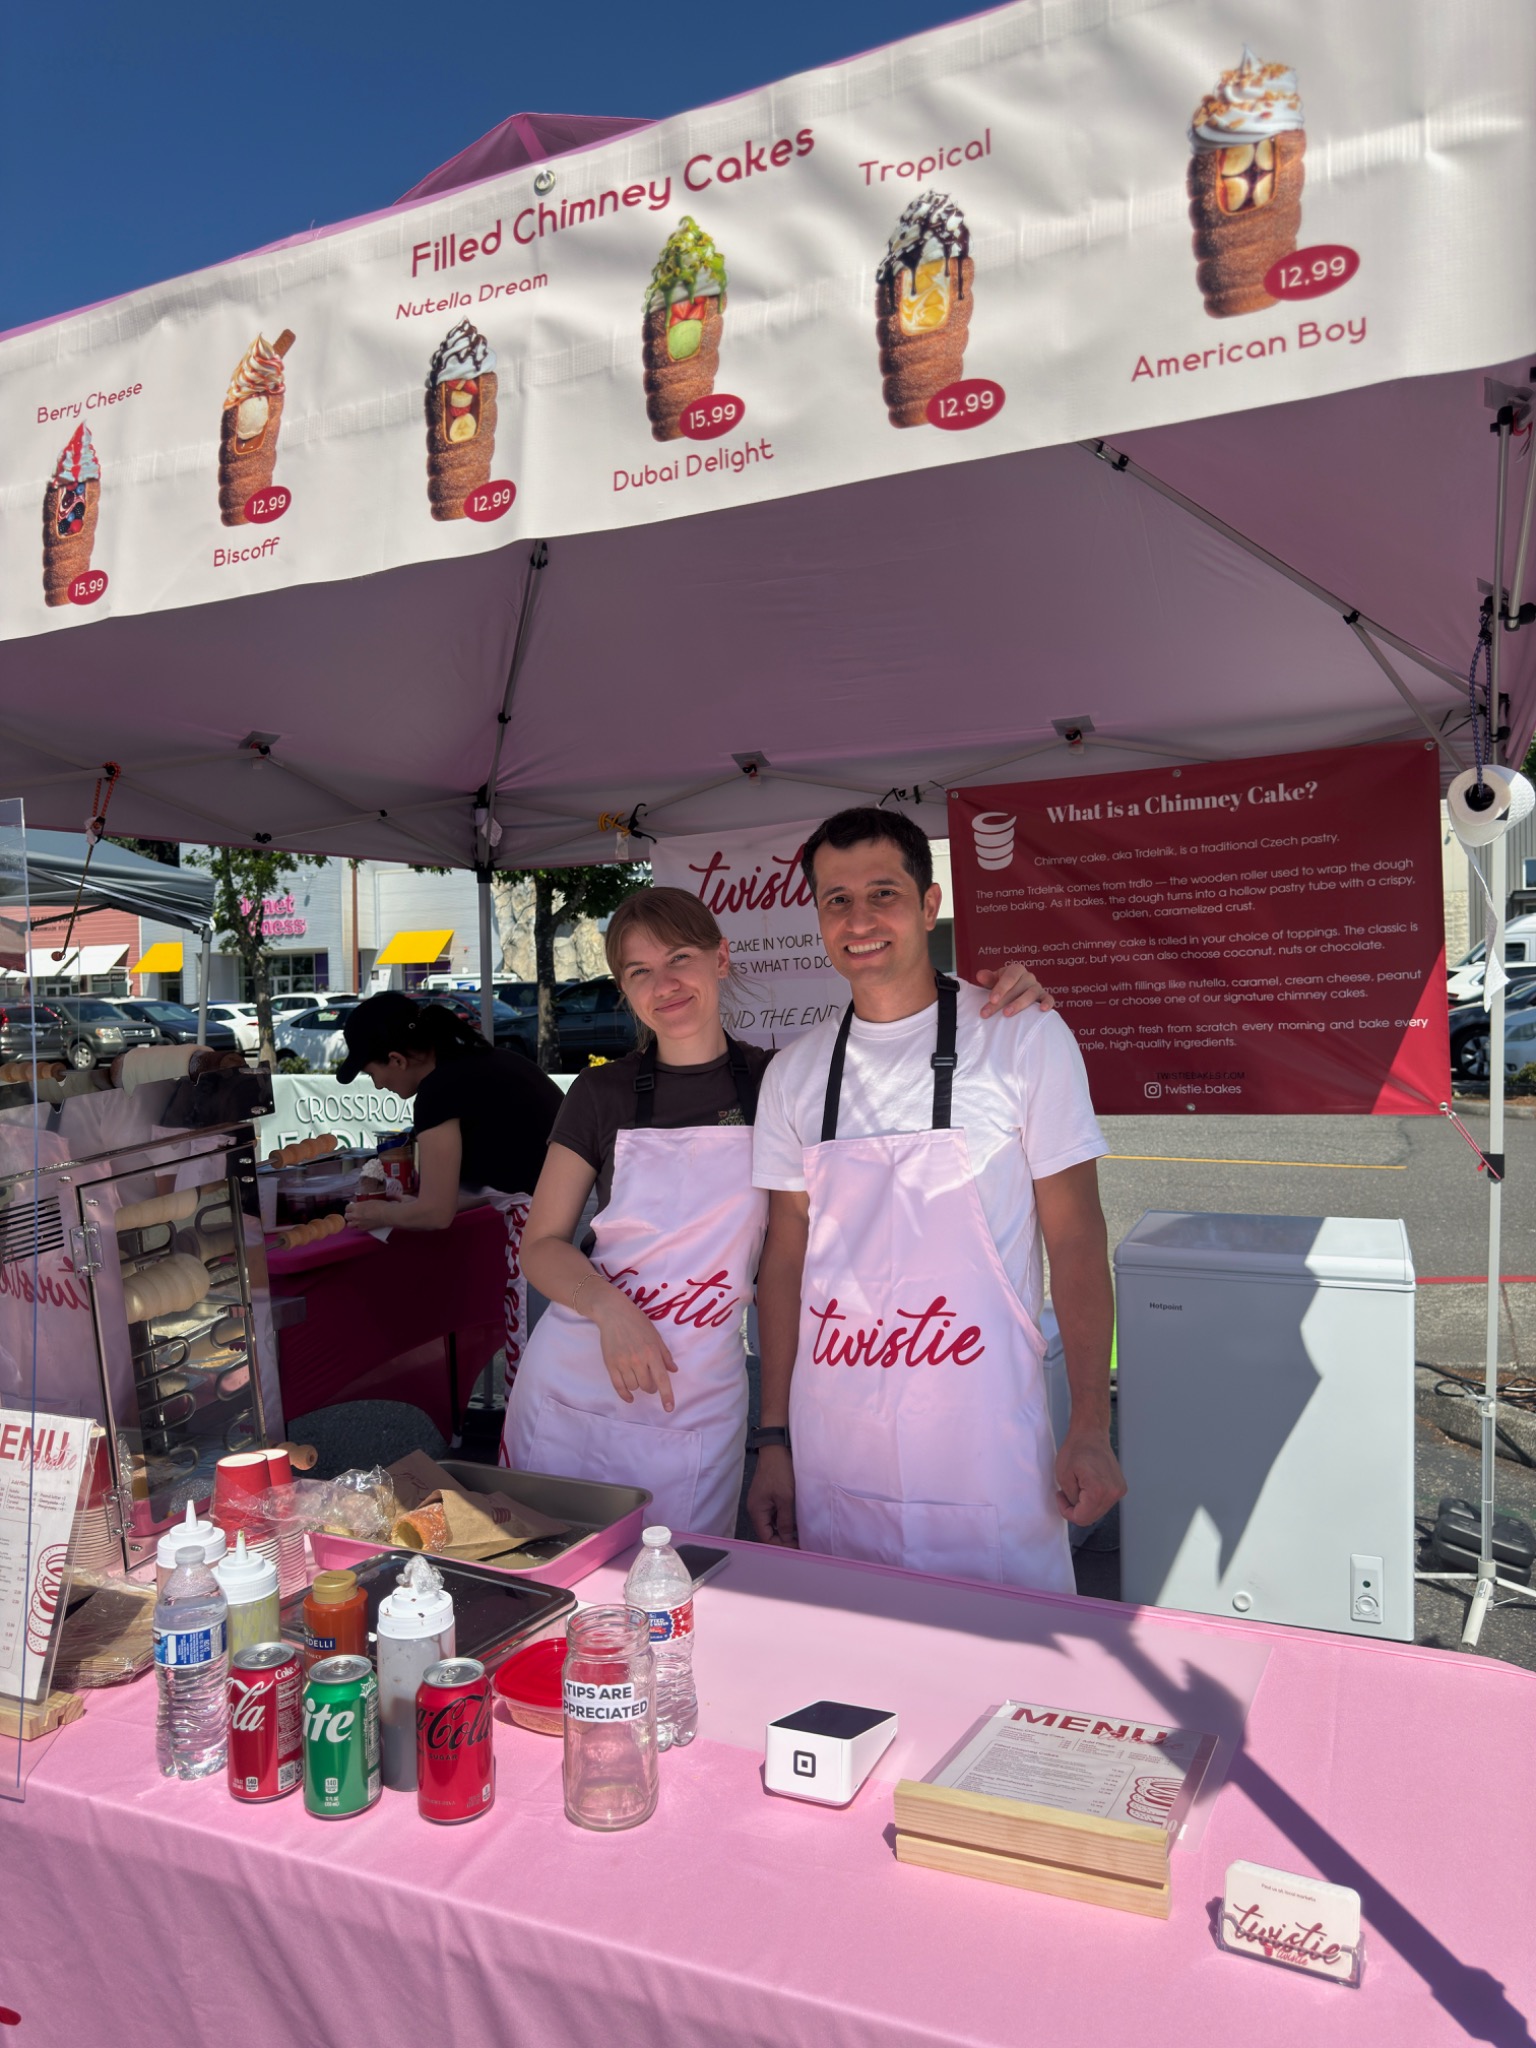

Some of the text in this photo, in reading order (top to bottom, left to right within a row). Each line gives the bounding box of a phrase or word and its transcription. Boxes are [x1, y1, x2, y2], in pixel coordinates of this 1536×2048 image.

[859, 128, 991, 185] Tropical
[412, 128, 814, 278] Filled Chimney Cakes
[396, 273, 549, 320] Nutella Dream
[1131, 317, 1367, 382] American Boy
[37, 383, 142, 424] Berry Cheese
[613, 436, 774, 492] Dubai Delight
[213, 536, 280, 567] Biscoff
[1046, 781, 1317, 822] What is a Chimney Cake?
[1034, 856, 1078, 866] Chimney
[1112, 851, 1132, 860] aka
[1180, 846, 1187, 854] is
[1200, 839, 1257, 852] traditional
[1260, 836, 1298, 847] Czech
[689, 844, 818, 915] twisti
[995, 889, 1024, 897] name
[1066, 884, 1100, 892] comes
[1102, 882, 1126, 890] from
[1128, 878, 1152, 888] trdlo
[1169, 876, 1187, 885] the
[1190, 873, 1237, 883] wooden
[1240, 870, 1268, 880] roller
[1270, 867, 1298, 878] used
[1302, 867, 1313, 875] to
[1316, 865, 1346, 874] wrap
[1350, 862, 1370, 871] the
[1373, 858, 1413, 870] dough
[976, 904, 1007, 913] before
[1050, 899, 1062, 907] As
[1065, 898, 1071, 906] it
[1128, 893, 1163, 904] dough
[1167, 892, 1192, 900] turns
[1195, 889, 1215, 898] into
[1230, 886, 1266, 896] hollow
[1270, 883, 1306, 895] pastry
[1308, 881, 1336, 890] tube
[1339, 878, 1363, 888] with
[1154, 904, 1222, 916] caramelized
[729, 938, 760, 953] CAKE
[763, 938, 774, 950] IN
[777, 934, 814, 949] YOUR
[978, 946, 1001, 954] After
[1042, 942, 1069, 951] each
[1072, 940, 1117, 949] chimney
[1119, 938, 1146, 947] cake
[1149, 937, 1155, 945] is
[1158, 936, 1186, 945] rolled
[1189, 935, 1198, 944] in
[1202, 935, 1226, 945] your
[1228, 932, 1268, 942] choice
[1272, 930, 1284, 939] of
[1344, 925, 1364, 934] The
[1368, 923, 1406, 934] classic
[1410, 922, 1418, 931] is
[751, 959, 789, 974] WHAT
[793, 958, 812, 970] TO
[1090, 954, 1108, 963] but
[1110, 954, 1129, 963] you
[1156, 951, 1178, 960] also
[1180, 950, 1220, 958] choose
[1278, 945, 1302, 954] nuts
[1071, 983, 1107, 994] special
[1110, 982, 1132, 991] with
[1134, 981, 1166, 991] fillings
[1168, 980, 1186, 988] like
[1284, 976, 1323, 985] cream
[1377, 970, 1422, 982] peanut
[1122, 996, 1161, 1005] choose
[1188, 993, 1200, 1003] of
[1224, 992, 1274, 1003] signature
[1277, 991, 1328, 1000] chimney
[760, 1007, 795, 1028] THE
[1100, 1026, 1134, 1036] dough
[1138, 1025, 1162, 1033] fresh
[1167, 1024, 1192, 1032] from
[1196, 1022, 1237, 1032] scratch
[1242, 1023, 1274, 1031] every
[1278, 1021, 1324, 1031] morning
[1330, 1020, 1354, 1029] and
[1358, 1019, 1389, 1028] bake
[1394, 1018, 1428, 1028] every
[1079, 1038, 1108, 1052] mple,
[1110, 1039, 1172, 1050] high-quality
[1165, 1084, 1241, 1094] twistie.bakes
[296, 1094, 414, 1124] CROSSROA
[1150, 1302, 1183, 1311] Hotpoint
[809, 1295, 985, 1368] twistie
[0, 1424, 70, 1466] ENU
[566, 1683, 632, 1700] TIPS ARE
[564, 1700, 648, 1719] PPRECIATED
[1011, 1708, 1168, 1745] MENU
